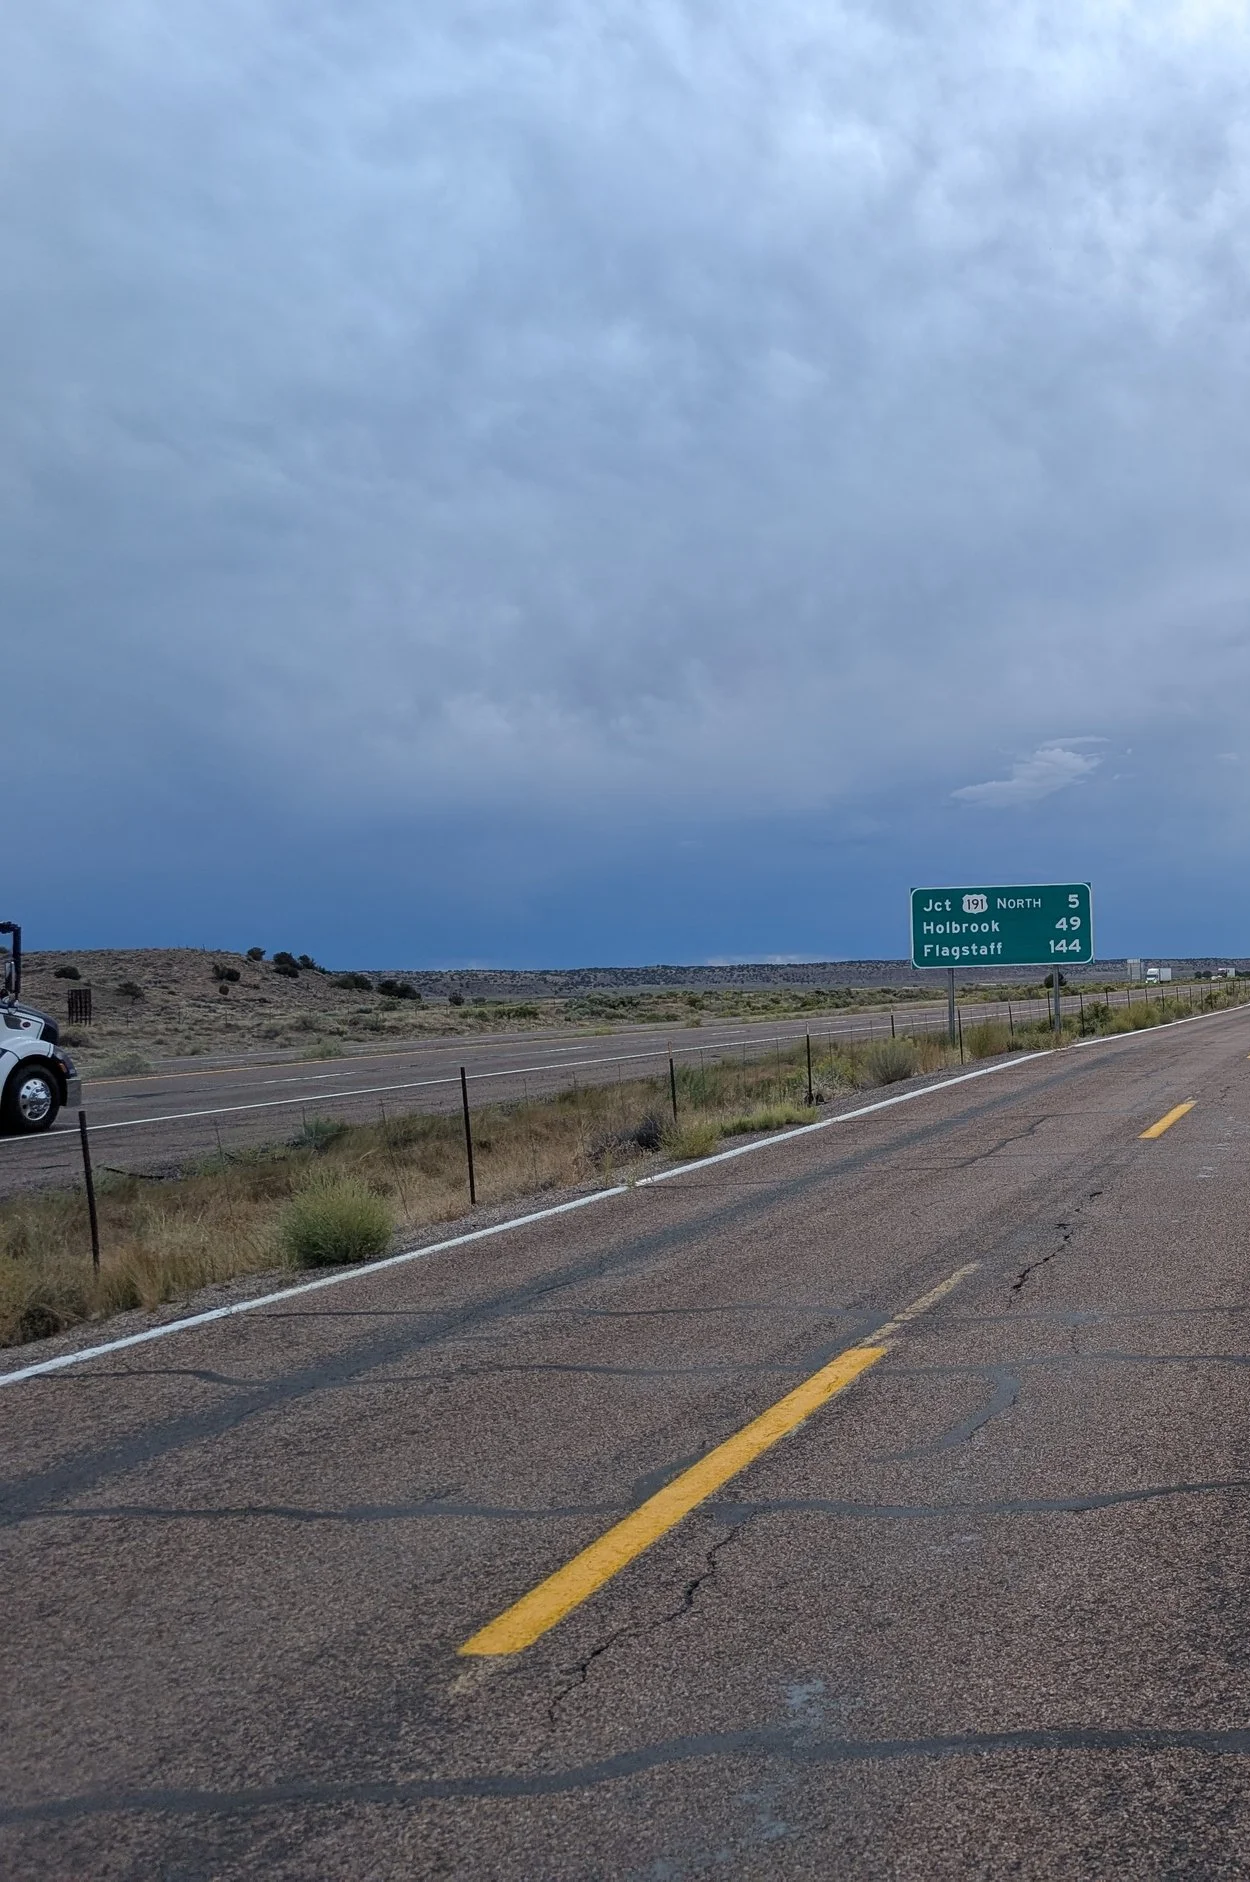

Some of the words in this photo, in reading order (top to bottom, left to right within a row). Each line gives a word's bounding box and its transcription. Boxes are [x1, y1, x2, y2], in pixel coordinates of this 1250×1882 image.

[923, 899, 952, 912] Jct
[966, 898, 985, 910] 191
[997, 898, 1042, 909] NORTH
[1068, 894, 1080, 908] 5
[923, 920, 1000, 934] Holbrook
[1055, 916, 1081, 931] 49
[924, 942, 1002, 960] Flagstaff
[1049, 939, 1081, 954] 144
